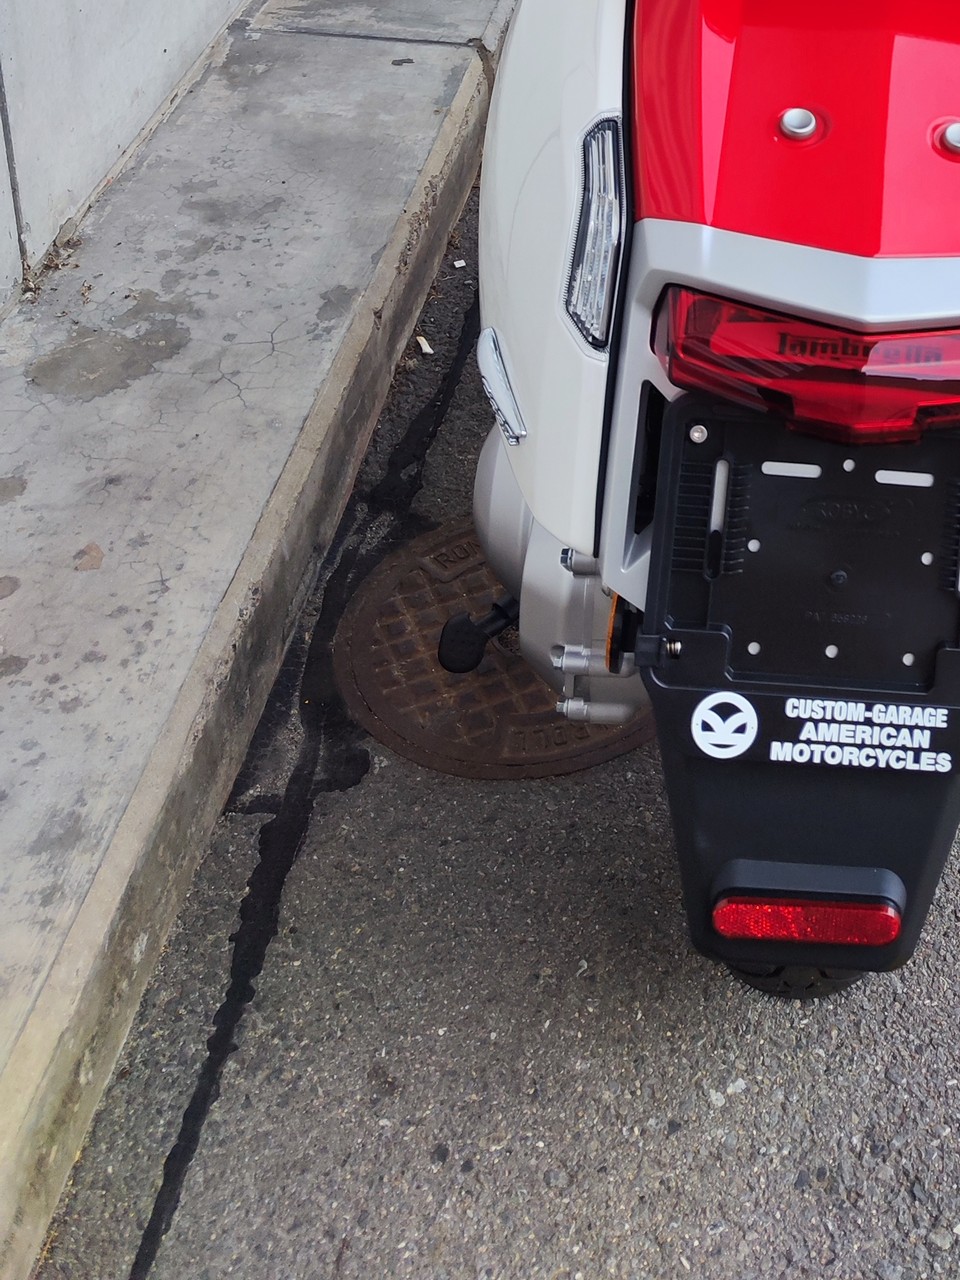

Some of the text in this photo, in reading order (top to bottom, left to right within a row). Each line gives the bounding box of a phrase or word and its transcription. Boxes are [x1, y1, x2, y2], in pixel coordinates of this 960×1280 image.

[785, 698, 948, 728] CUSTOM-GARAGE
[799, 721, 931, 748] AMERICAN
[770, 741, 952, 772] MOTORCYCLES
